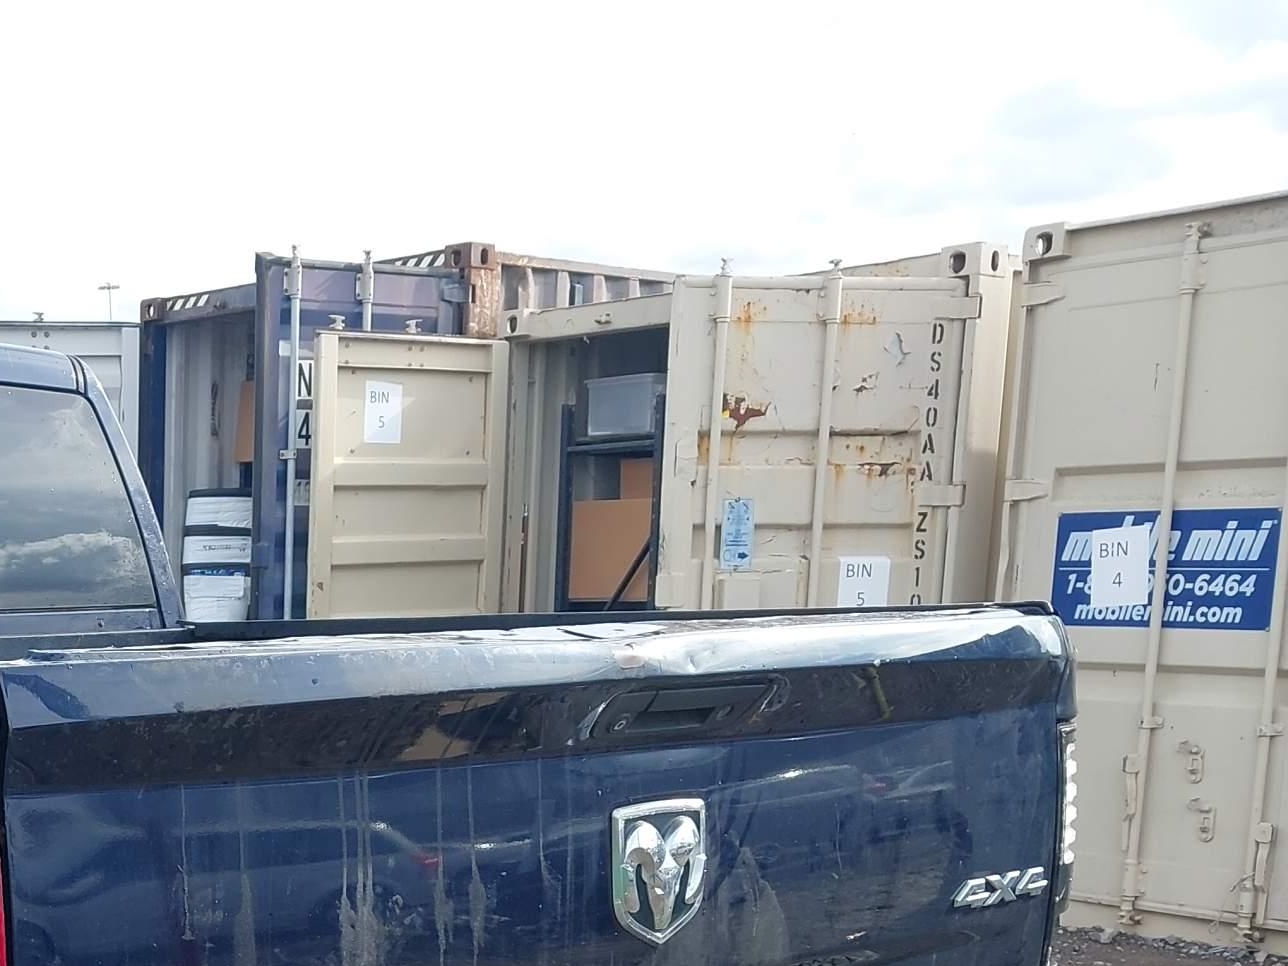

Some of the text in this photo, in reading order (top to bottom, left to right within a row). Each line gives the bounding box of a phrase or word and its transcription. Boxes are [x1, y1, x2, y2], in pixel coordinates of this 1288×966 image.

[369, 391, 390, 404] BIN
[378, 416, 385, 429] 5
[1061, 515, 1273, 561] mle mini
[1099, 540, 1129, 559] BIN
[846, 563, 872, 578] BIN
[1067, 574, 1255, 597] 1-80-6464
[1112, 571, 1123, 588] 4
[856, 592, 865, 606] 5
